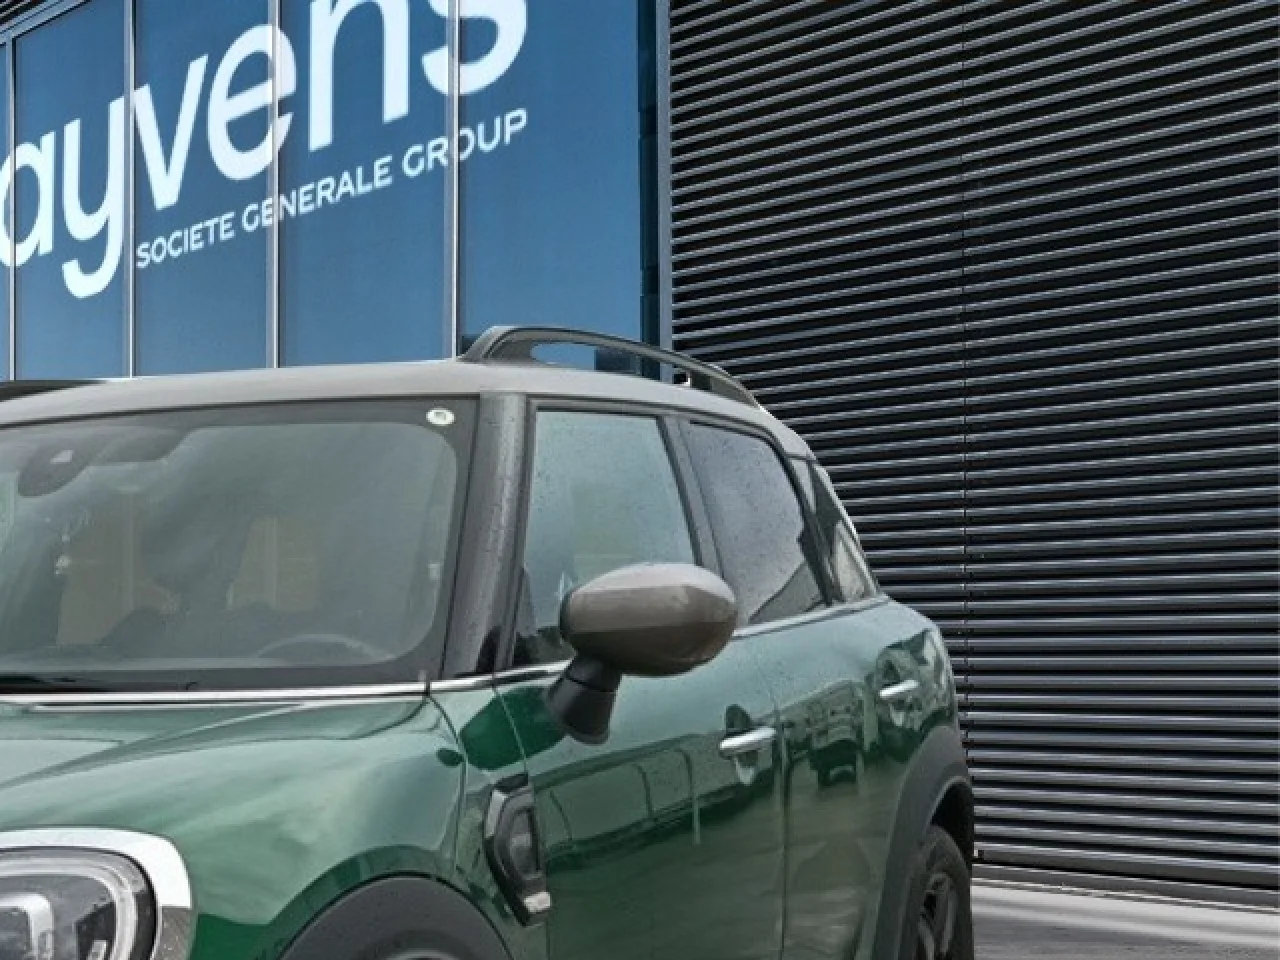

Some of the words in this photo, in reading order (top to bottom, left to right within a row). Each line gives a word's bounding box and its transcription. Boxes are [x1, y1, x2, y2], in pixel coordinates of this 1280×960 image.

[135, 211, 235, 269] SOCIETE
[241, 155, 394, 230] GENERALE
[401, 107, 527, 178] GROUP
